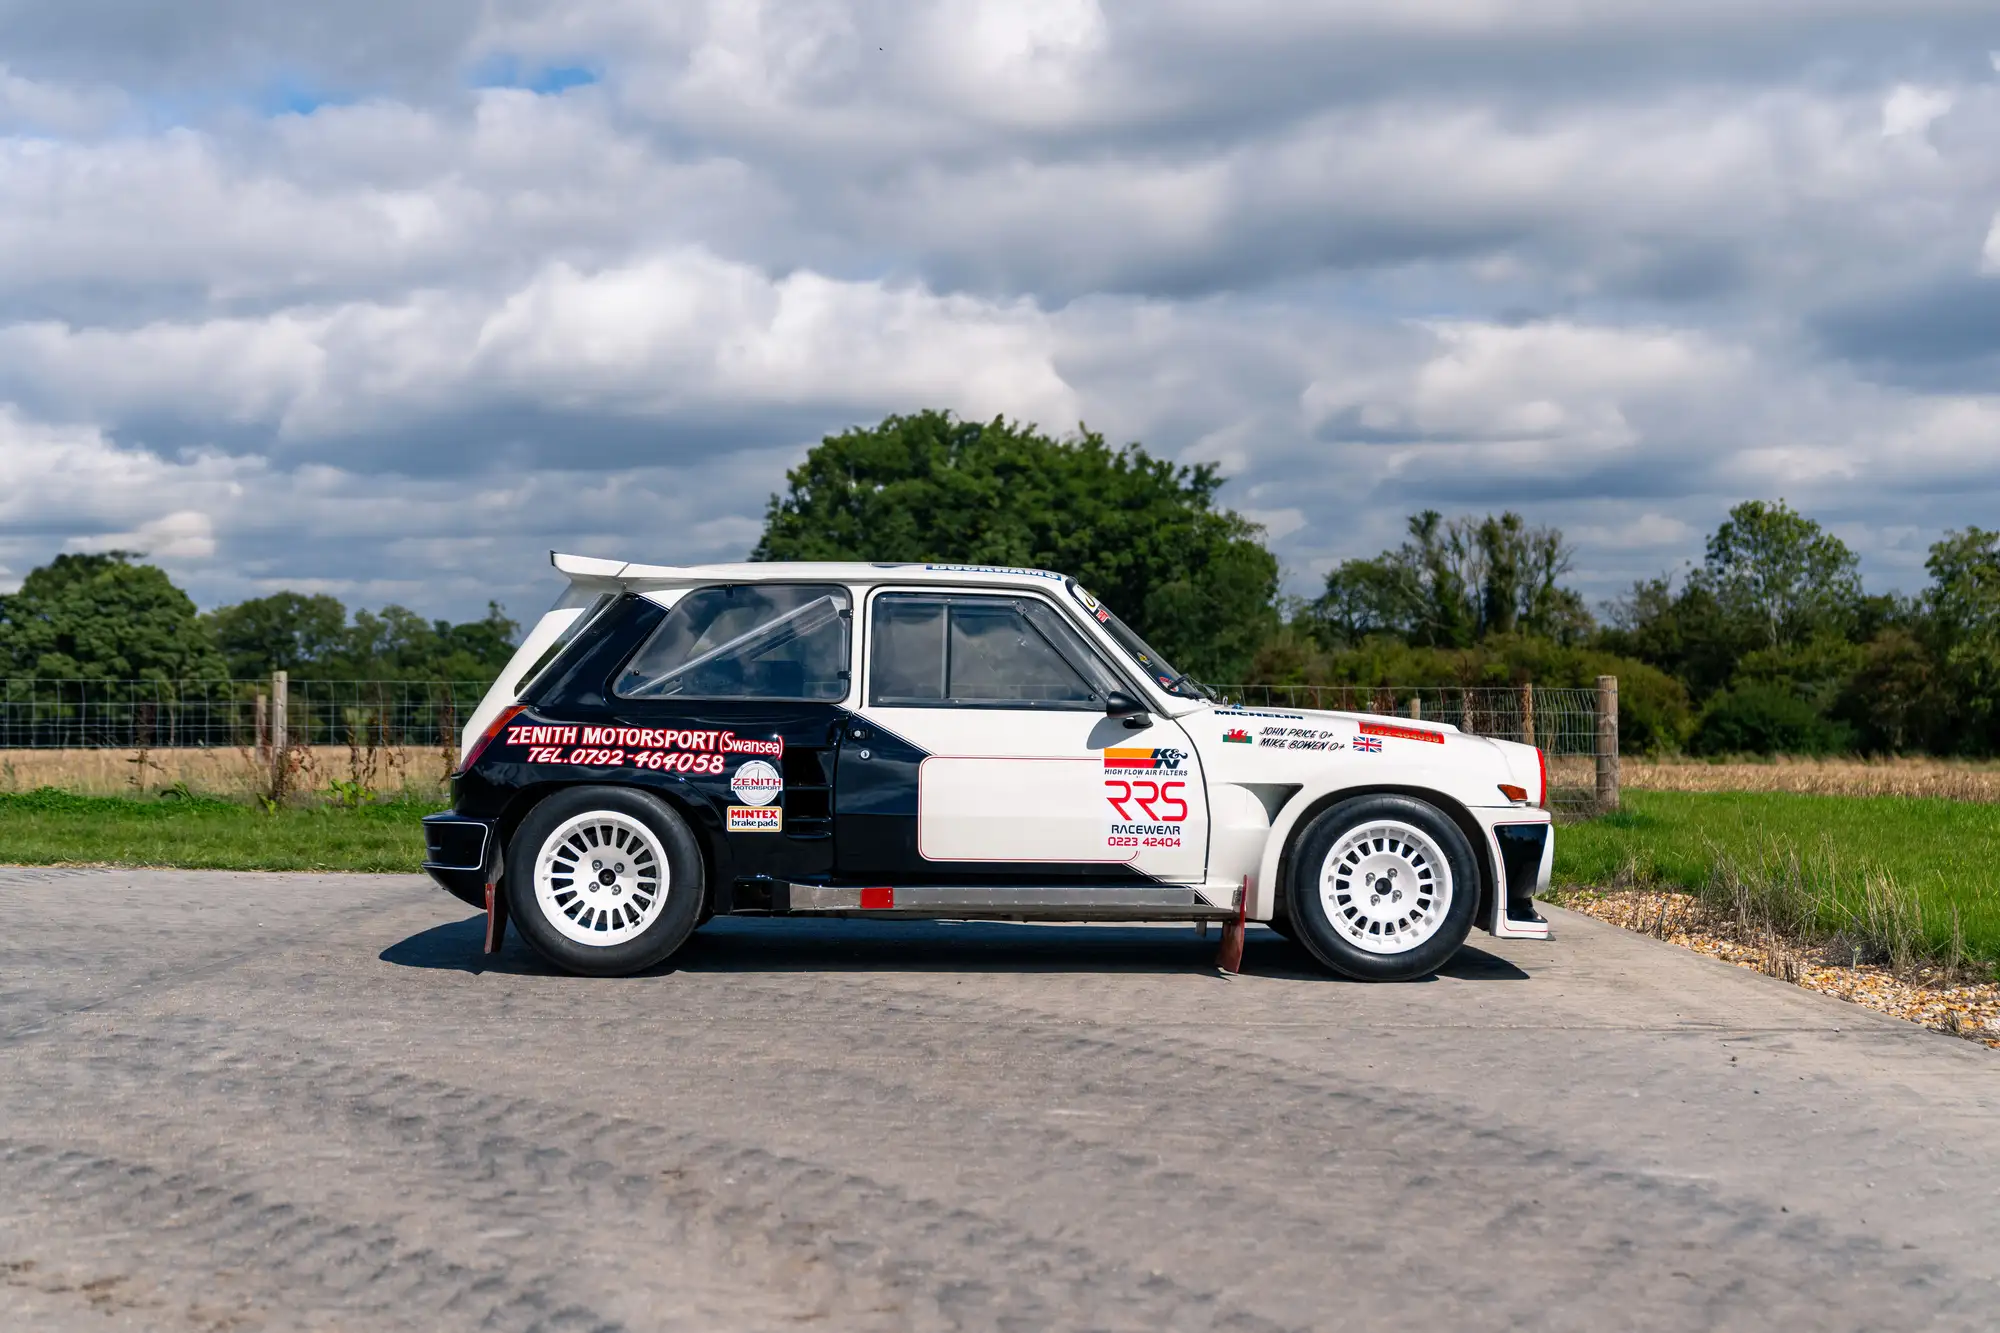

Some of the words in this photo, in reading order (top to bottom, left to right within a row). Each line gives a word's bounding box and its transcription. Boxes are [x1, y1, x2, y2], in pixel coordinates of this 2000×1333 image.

[1214, 710, 1303, 720] MICHELIN
[1259, 727, 1287, 736] JOHN
[1288, 729, 1318, 738] PRICE
[507, 726, 578, 745] ZENITH
[582, 727, 719, 750] MOTORSPORT
[719, 730, 784, 759] (Swansea)
[1260, 738, 1288, 748] MIKE
[1288, 740, 1329, 750] BOWEN
[1105, 781, 1188, 821] RRS
[731, 810, 777, 818] MINTEX
[757, 819, 778, 828] pads
[1111, 825, 1180, 834] RACEWEAR
[1108, 837, 1138, 846] 0223
[1143, 837, 1181, 847] 42404
